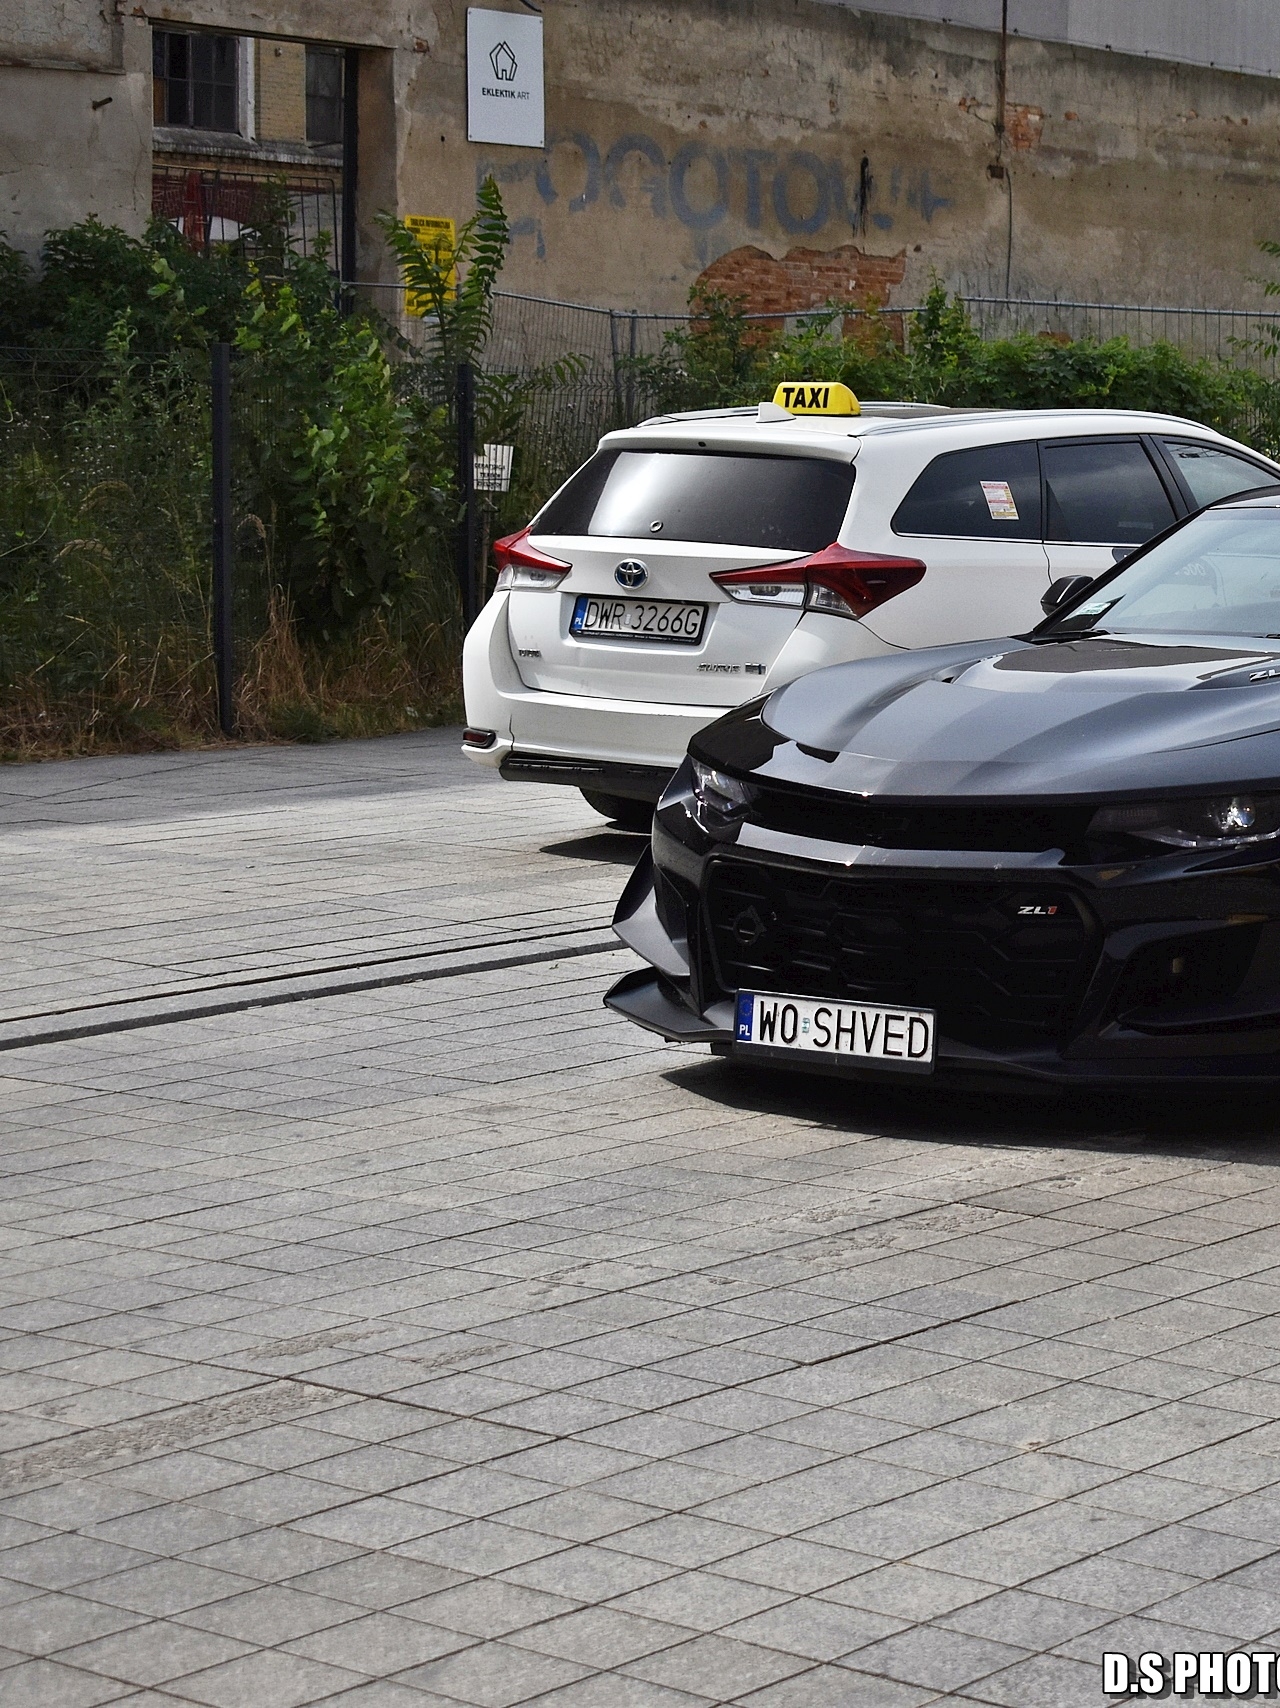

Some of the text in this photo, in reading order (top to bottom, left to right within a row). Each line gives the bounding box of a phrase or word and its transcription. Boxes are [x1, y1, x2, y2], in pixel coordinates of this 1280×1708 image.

[482, 87, 530, 100] EKLEKTIK ART
[782, 387, 830, 409] TAXI
[584, 601, 700, 635] DWR 3266G
[1017, 905, 1058, 915] ZL1
[739, 1024, 751, 1036] PL
[759, 1000, 929, 1058] WO SHVED
